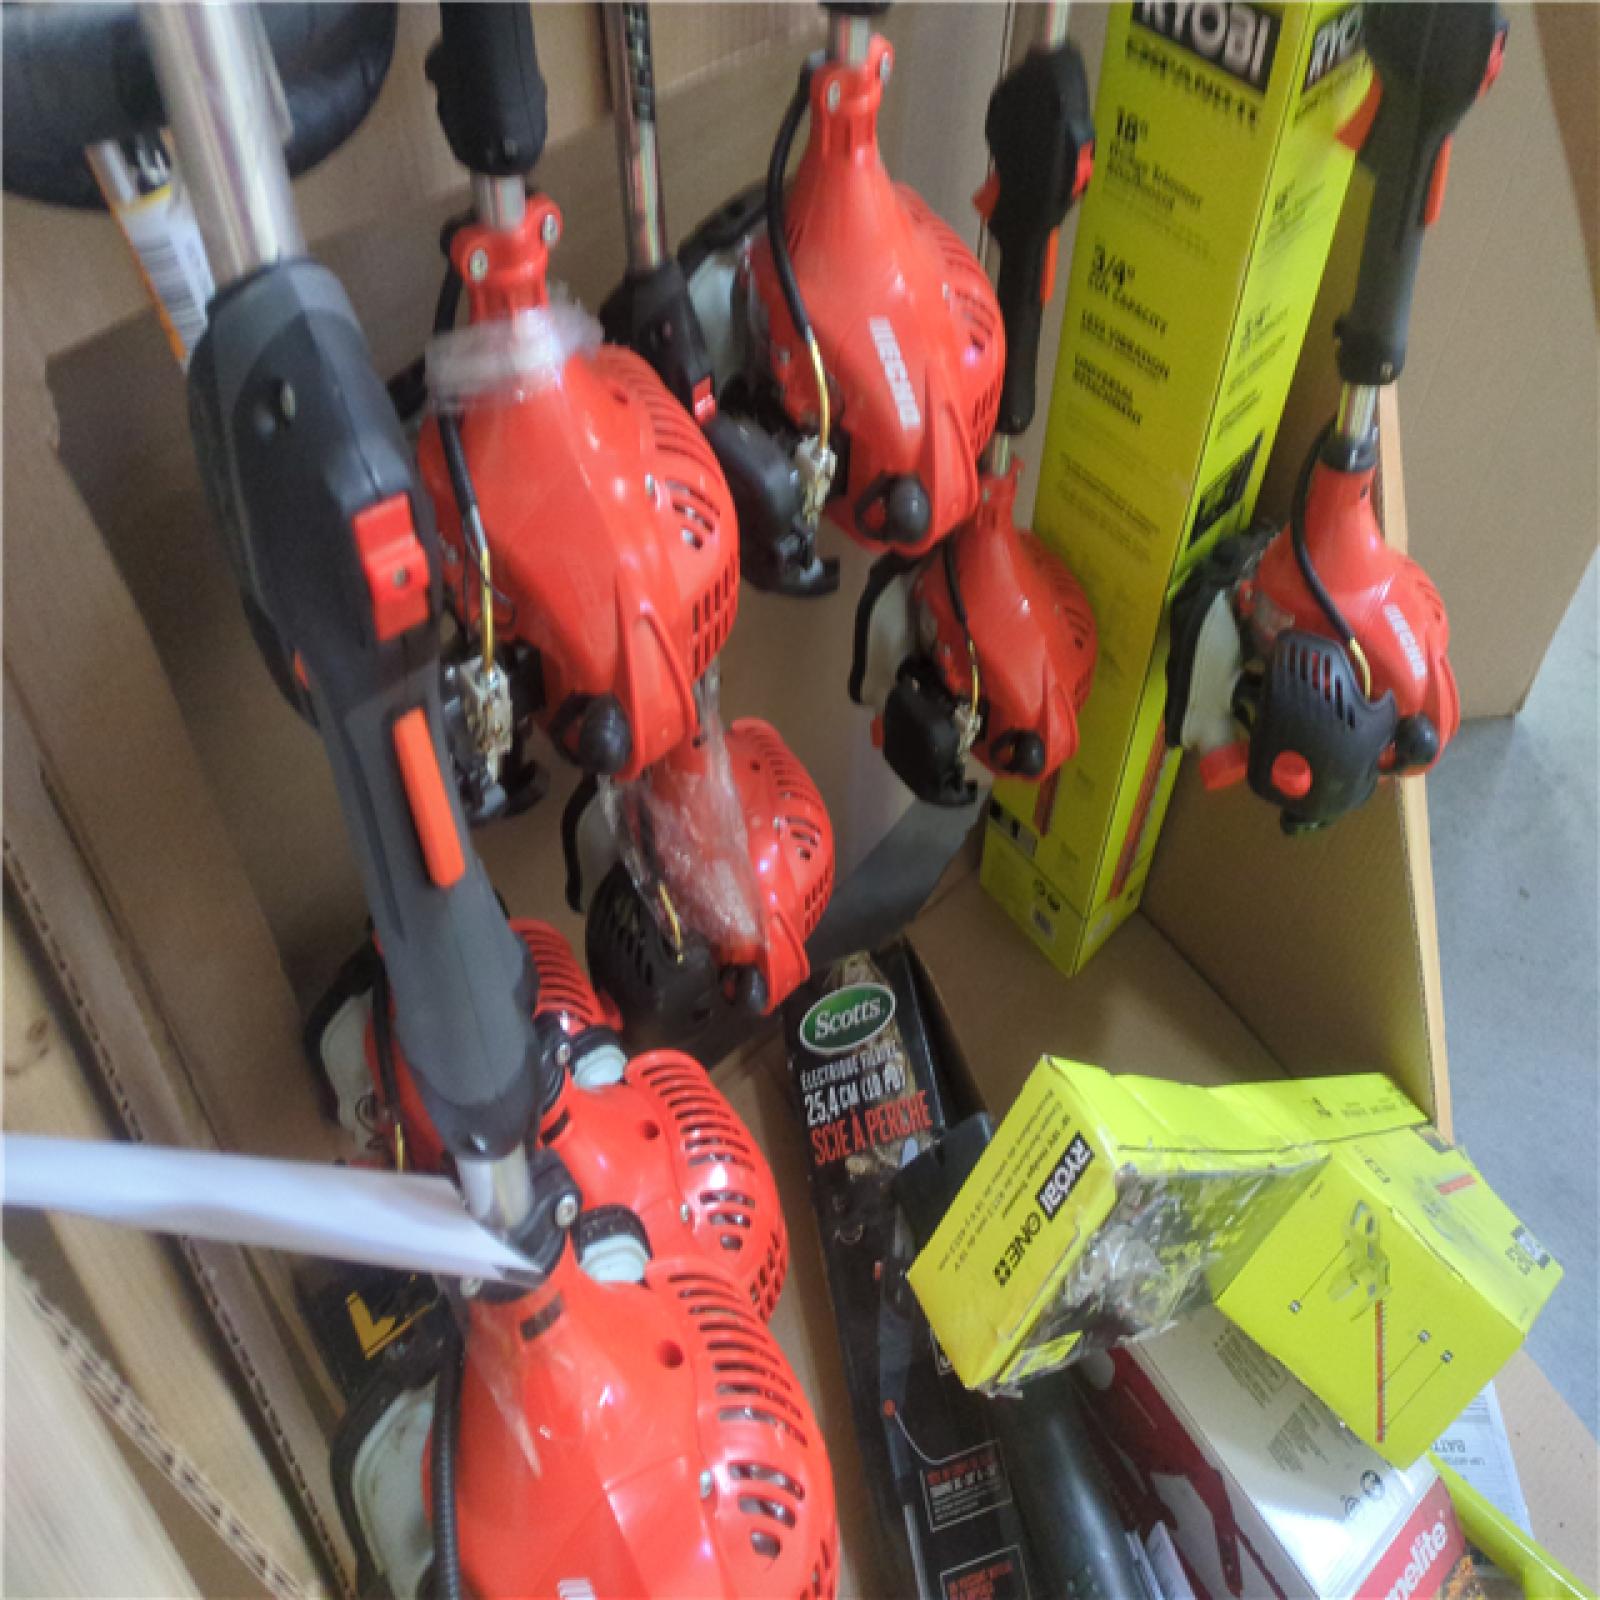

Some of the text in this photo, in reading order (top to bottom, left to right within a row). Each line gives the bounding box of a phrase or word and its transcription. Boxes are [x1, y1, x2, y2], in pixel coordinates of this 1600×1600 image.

[814, 997, 882, 1041] Scotts
[809, 1119, 851, 1166] SCIE
[865, 1089, 933, 1149] PERCHE
[1039, 1136, 1093, 1216] RYOBI
